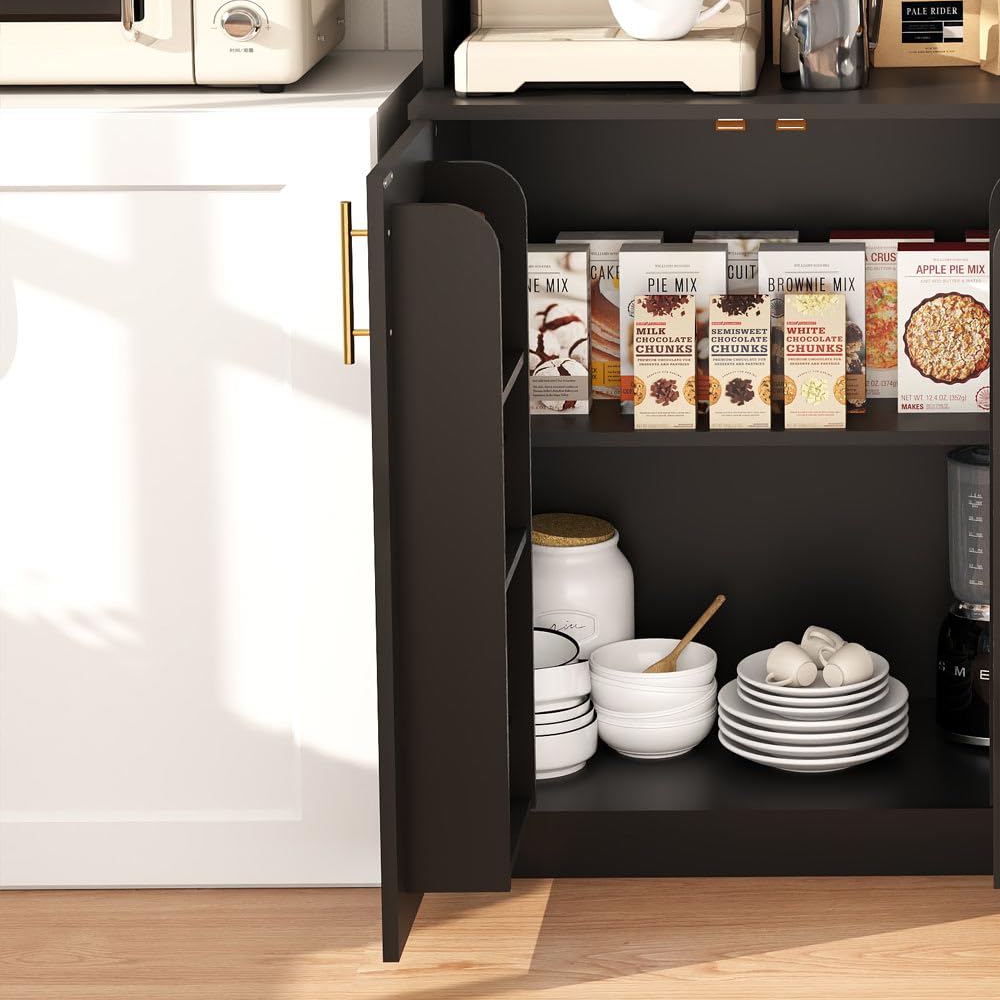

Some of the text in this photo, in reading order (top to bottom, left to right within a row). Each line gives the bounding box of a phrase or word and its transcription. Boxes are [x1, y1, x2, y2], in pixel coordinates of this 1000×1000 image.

[907, 7, 958, 16] PALE RIDER
[871, 252, 898, 262] CRUS
[916, 265, 985, 274] APPLE PIE MIX
[546, 278, 569, 292] MIX
[648, 278, 697, 292] PIE MIX
[768, 277, 856, 292] BROWNIE MIX
[636, 345, 693, 353] CHUNKS
[711, 345, 768, 353] CHUNKS
[786, 345, 843, 353] CHUNKS
